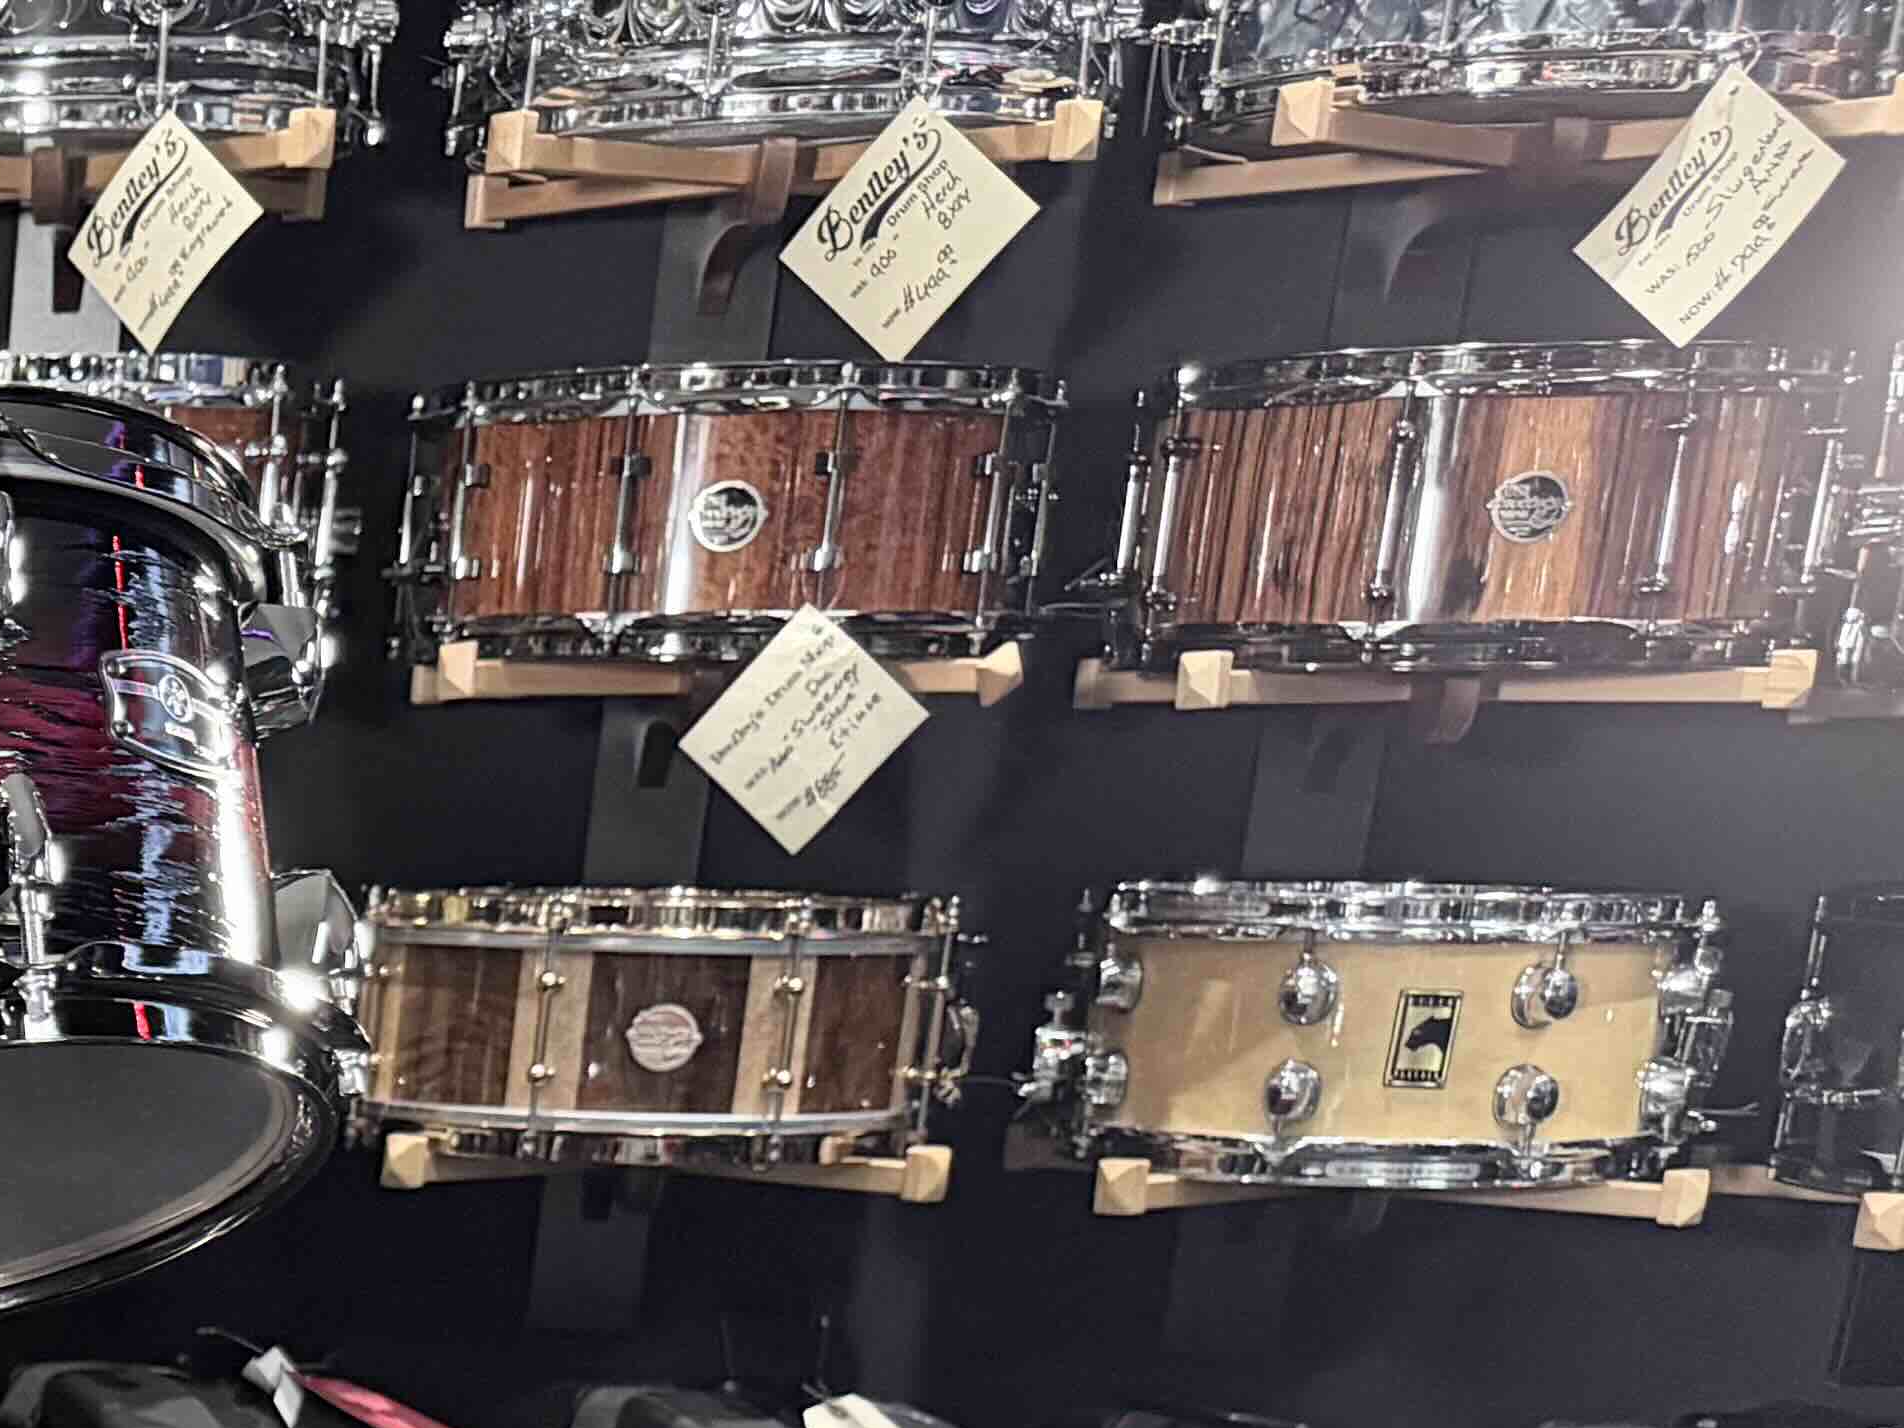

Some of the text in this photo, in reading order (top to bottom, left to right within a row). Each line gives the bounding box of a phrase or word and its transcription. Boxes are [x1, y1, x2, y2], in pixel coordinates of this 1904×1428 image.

[86, 128, 178, 267] Bentley's
[817, 127, 929, 263] Bentley's
[886, 191, 919, 228] Drum
[1614, 126, 1724, 257] Bentley's
[1645, 262, 1682, 296] WAS:
[1678, 288, 1718, 325] NOW:
